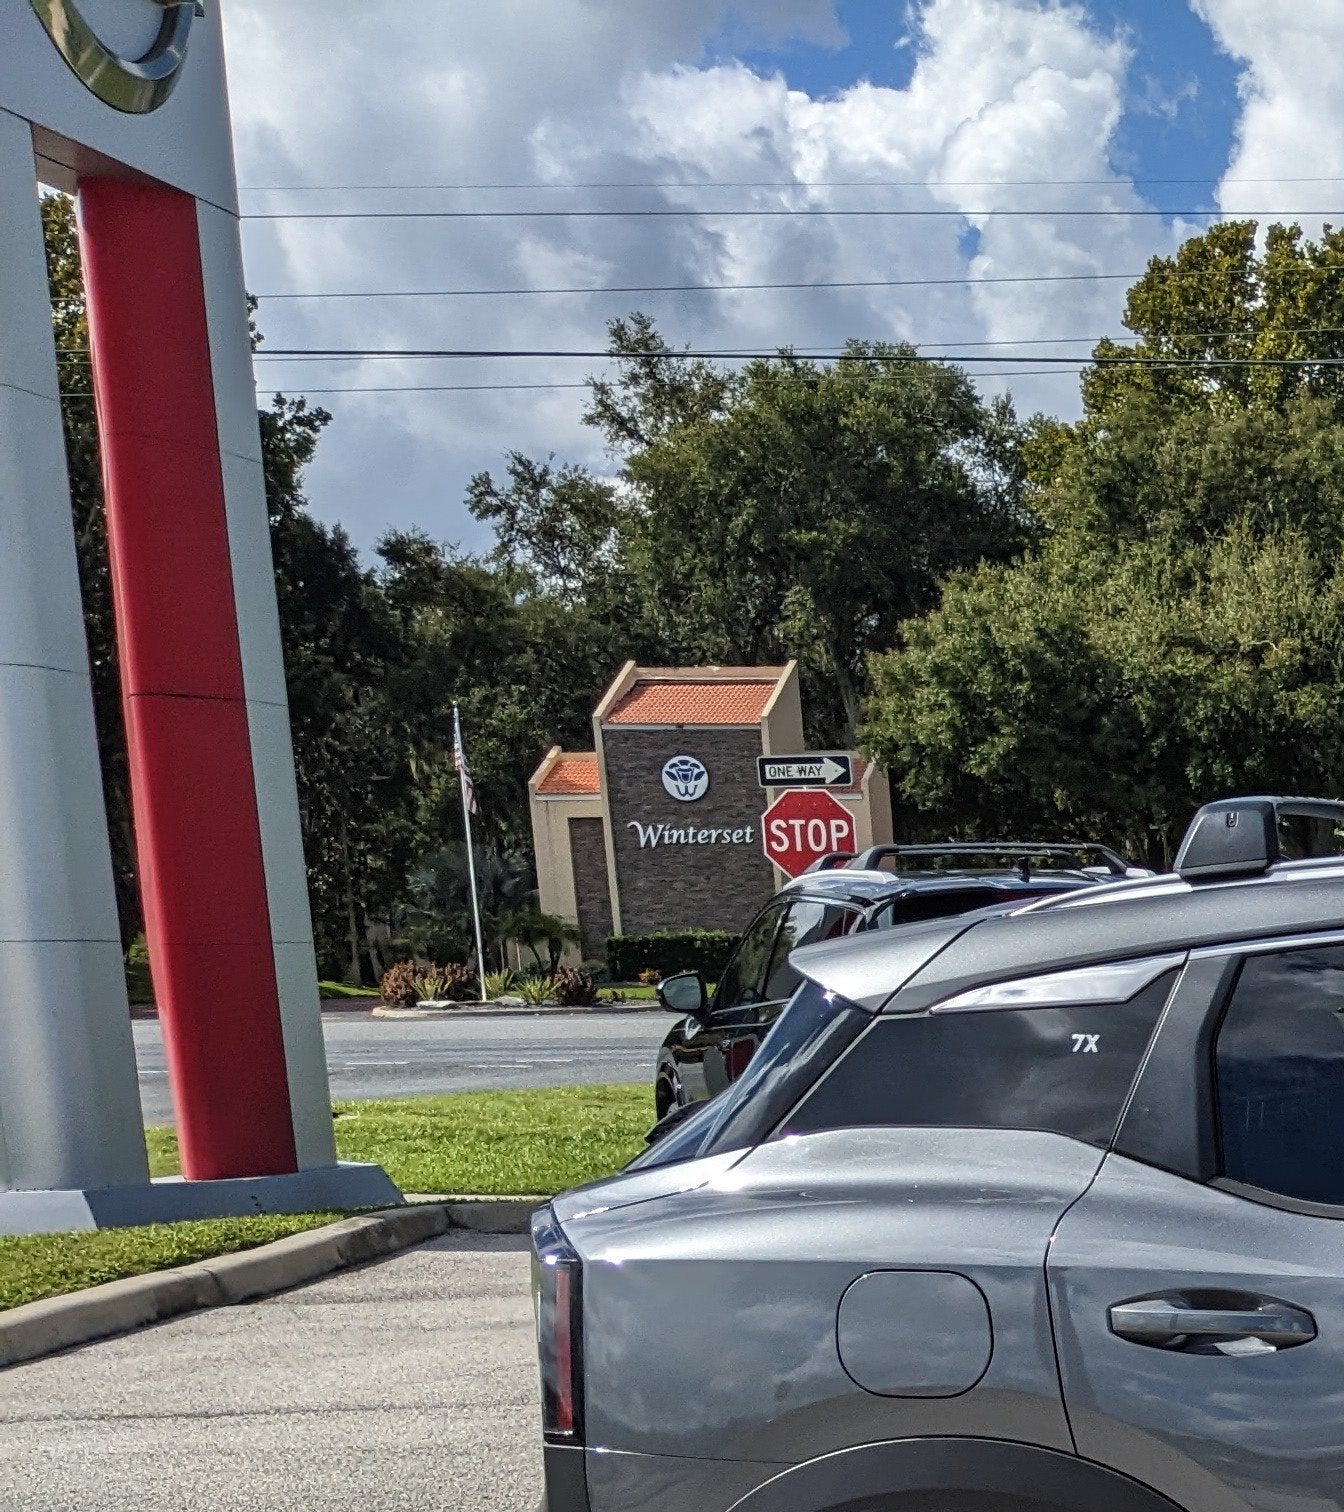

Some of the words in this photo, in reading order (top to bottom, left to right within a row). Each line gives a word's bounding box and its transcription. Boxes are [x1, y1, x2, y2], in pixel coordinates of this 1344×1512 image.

[768, 765, 793, 778] ONE
[797, 764, 823, 777] WAY
[626, 821, 755, 848] Winterset
[770, 818, 850, 852] STOP
[1071, 1033, 1100, 1053] 7X
